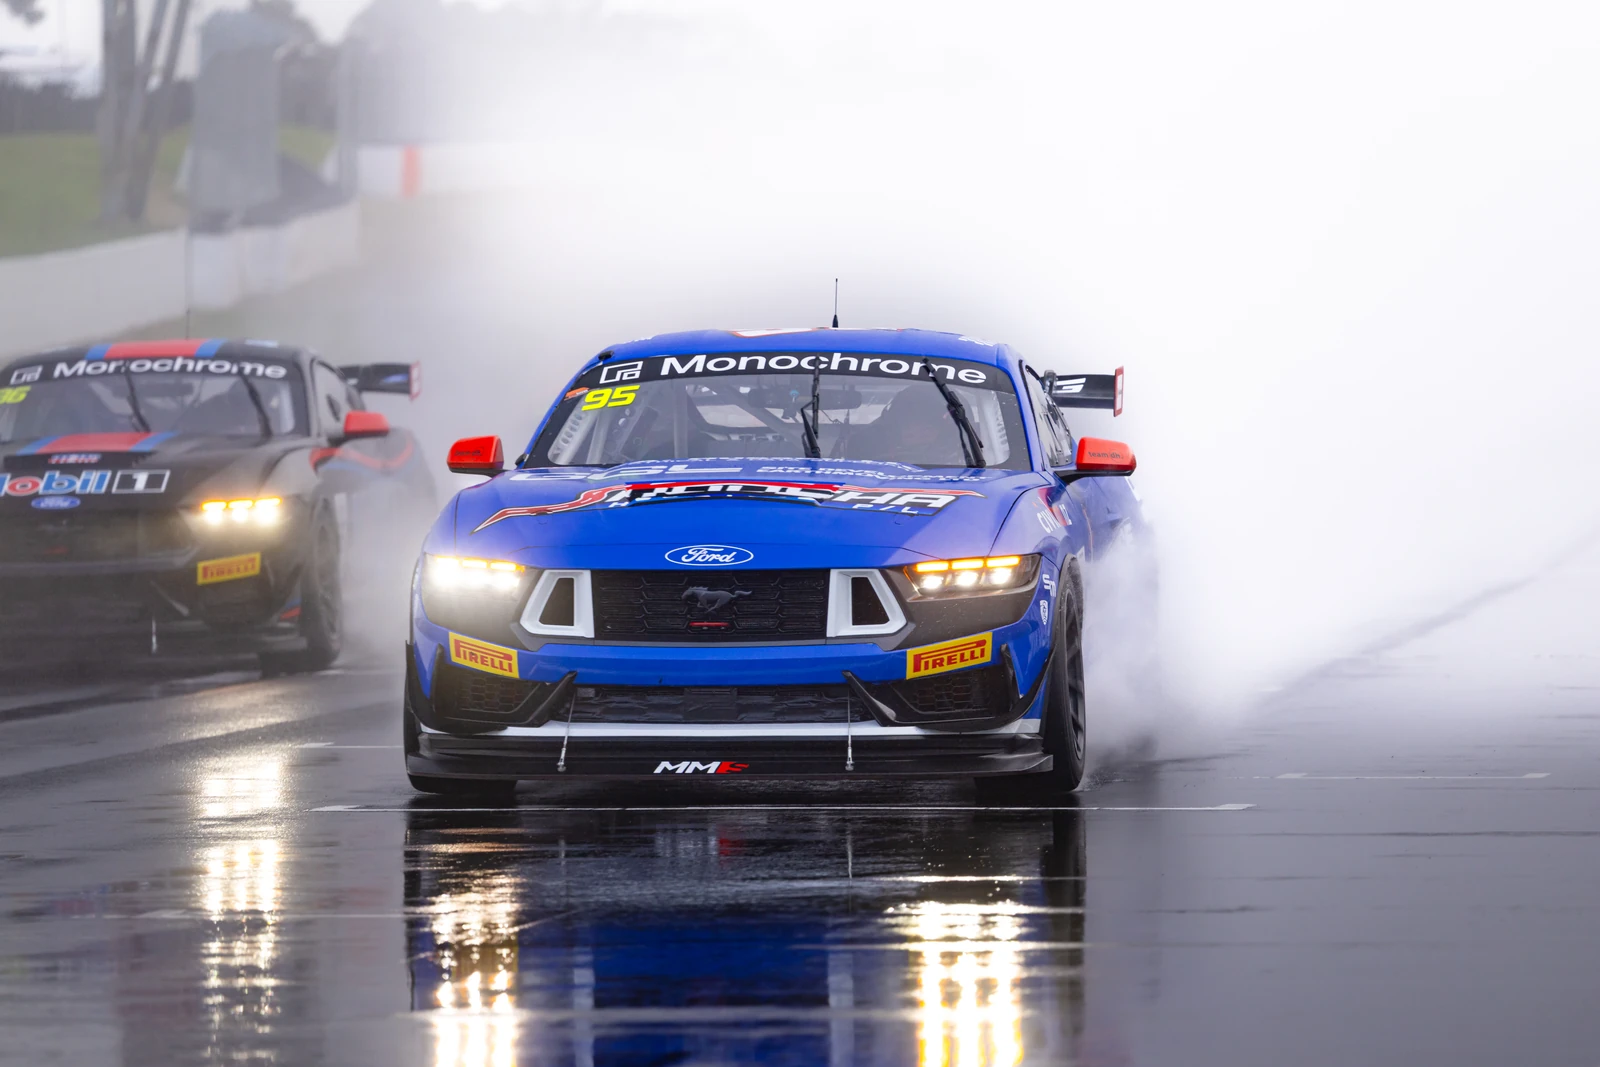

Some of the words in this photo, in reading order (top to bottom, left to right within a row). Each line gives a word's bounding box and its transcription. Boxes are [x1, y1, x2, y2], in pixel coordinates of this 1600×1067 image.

[53, 357, 287, 378] Monochrome
[660, 352, 987, 383] Monochrome
[581, 385, 640, 411] 95
[681, 547, 737, 562] Ford
[454, 639, 513, 673] PIRELLI
[913, 639, 987, 673] PIRELLI
